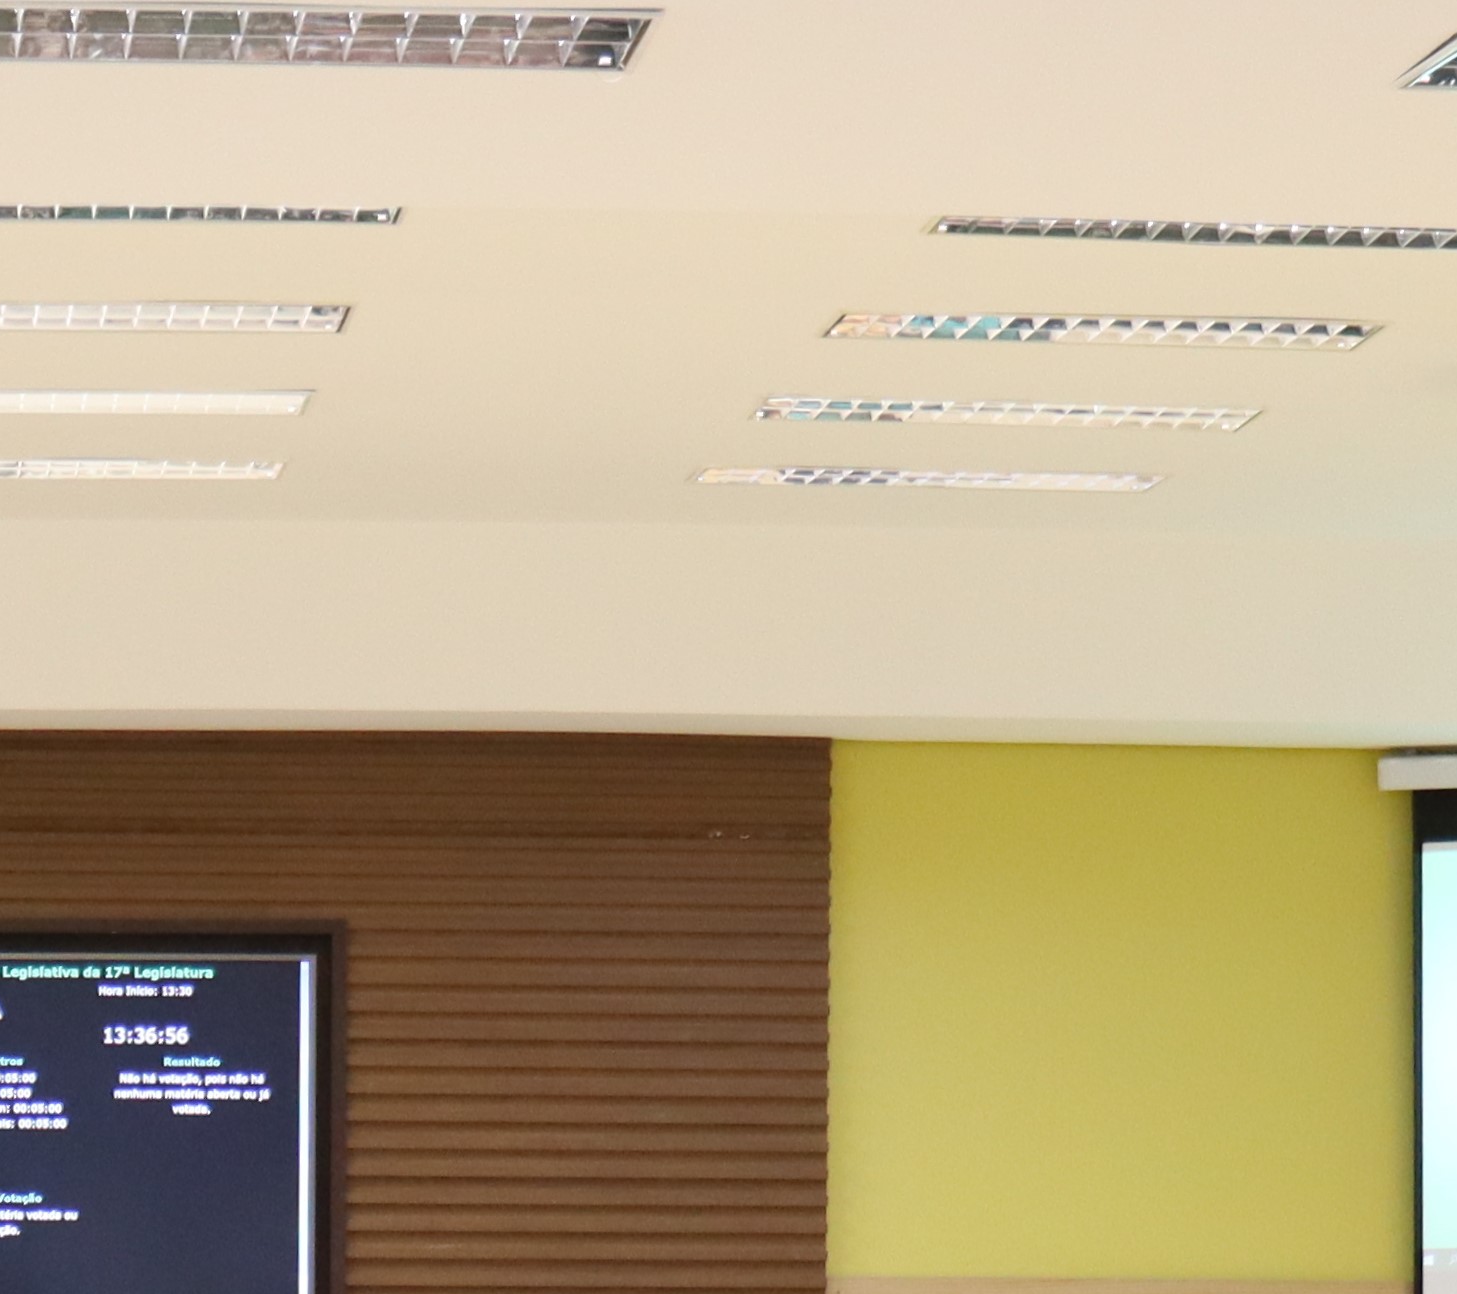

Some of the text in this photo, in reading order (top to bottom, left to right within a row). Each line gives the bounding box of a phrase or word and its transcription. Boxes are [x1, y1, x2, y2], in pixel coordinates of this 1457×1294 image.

[2, 966, 80, 980] Legislativa
[83, 967, 100, 979] da
[105, 967, 130, 979] 17ª
[134, 967, 214, 980] Legislatura
[98, 985, 193, 997] Hora Início: 13:30
[103, 1026, 190, 1045] 13:36:56
[163, 1056, 221, 1067] Resultado
[119, 1072, 140, 1084] Não
[142, 1072, 156, 1084] há
[205, 1073, 226, 1086] pois
[229, 1073, 248, 1084] não
[251, 1073, 265, 1085] há
[113, 1088, 270, 1102] nenhuma matéria aberta ou já
[26, 1209, 62, 1221] votada
[64, 1210, 78, 1221] ou
